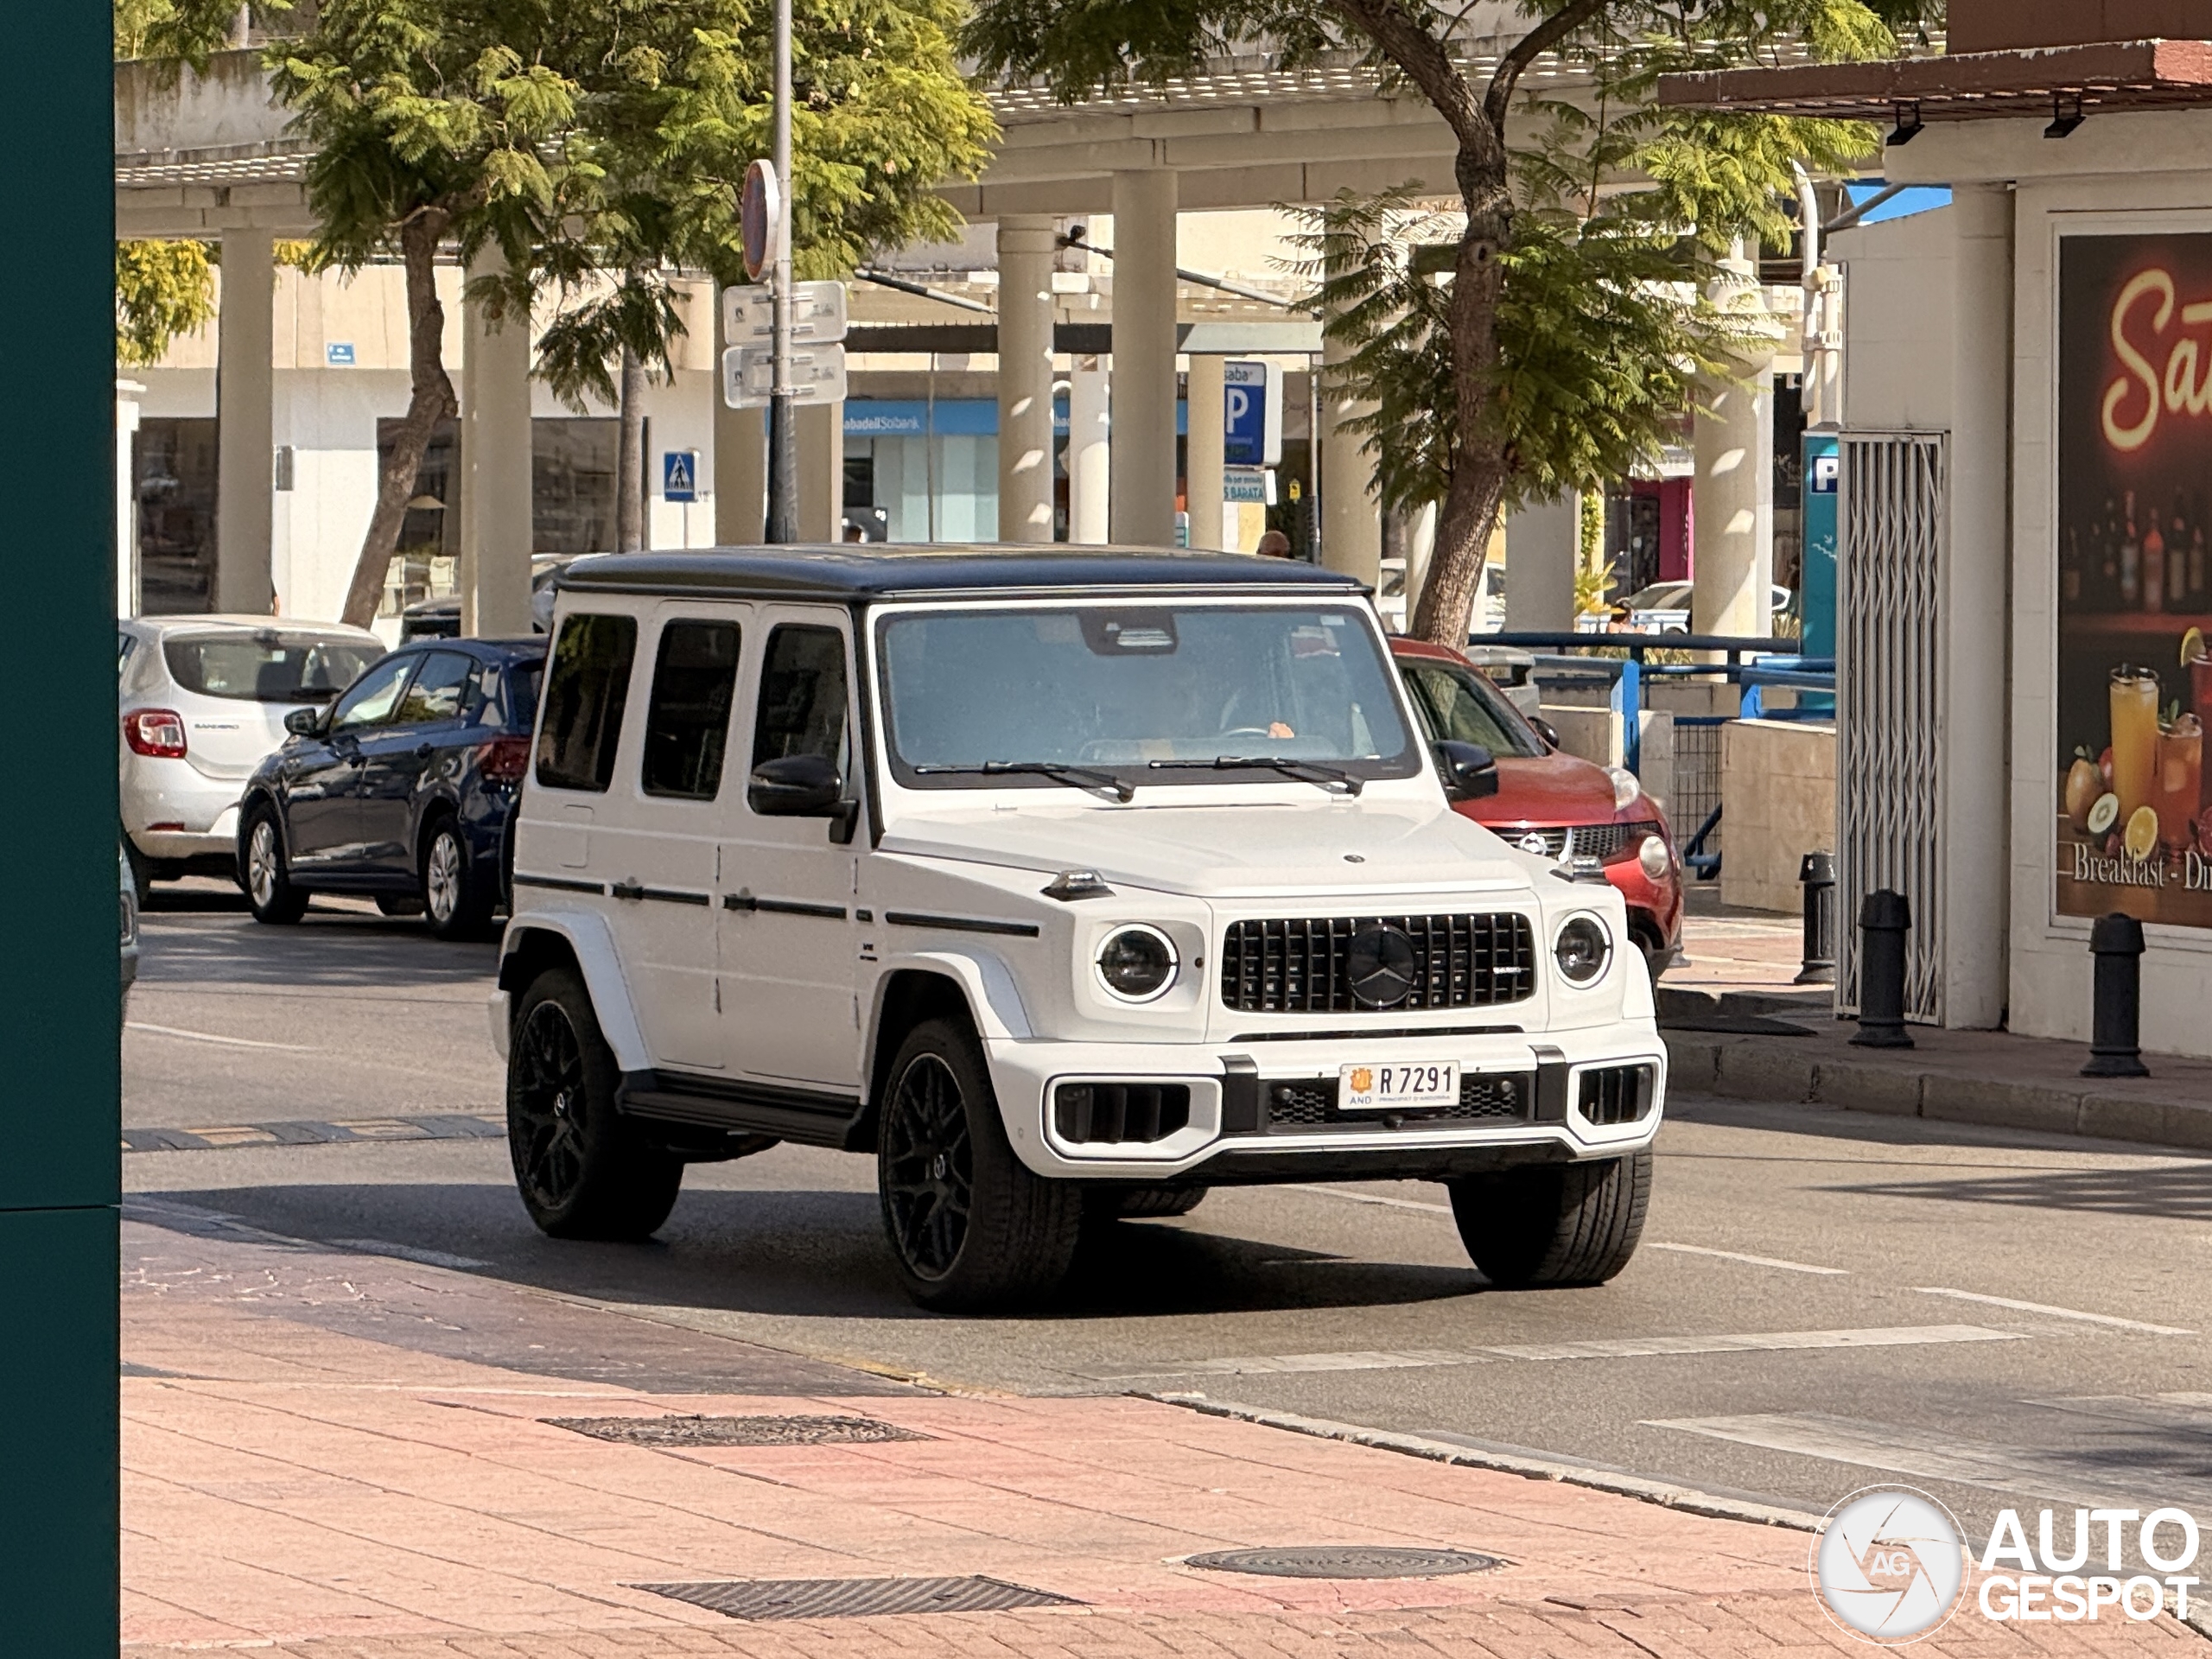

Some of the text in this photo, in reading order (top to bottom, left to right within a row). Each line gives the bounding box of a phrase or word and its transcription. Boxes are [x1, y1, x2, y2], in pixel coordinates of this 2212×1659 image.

[844, 416, 920, 430] abadellSolbank
[1227, 388, 1249, 434] P
[1816, 458, 1839, 491] P
[1230, 486, 1263, 499] BARATA
[2074, 842, 2164, 887] Breakfast
[1380, 1065, 1452, 1094] R 7291
[1350, 1096, 1372, 1105] AND
